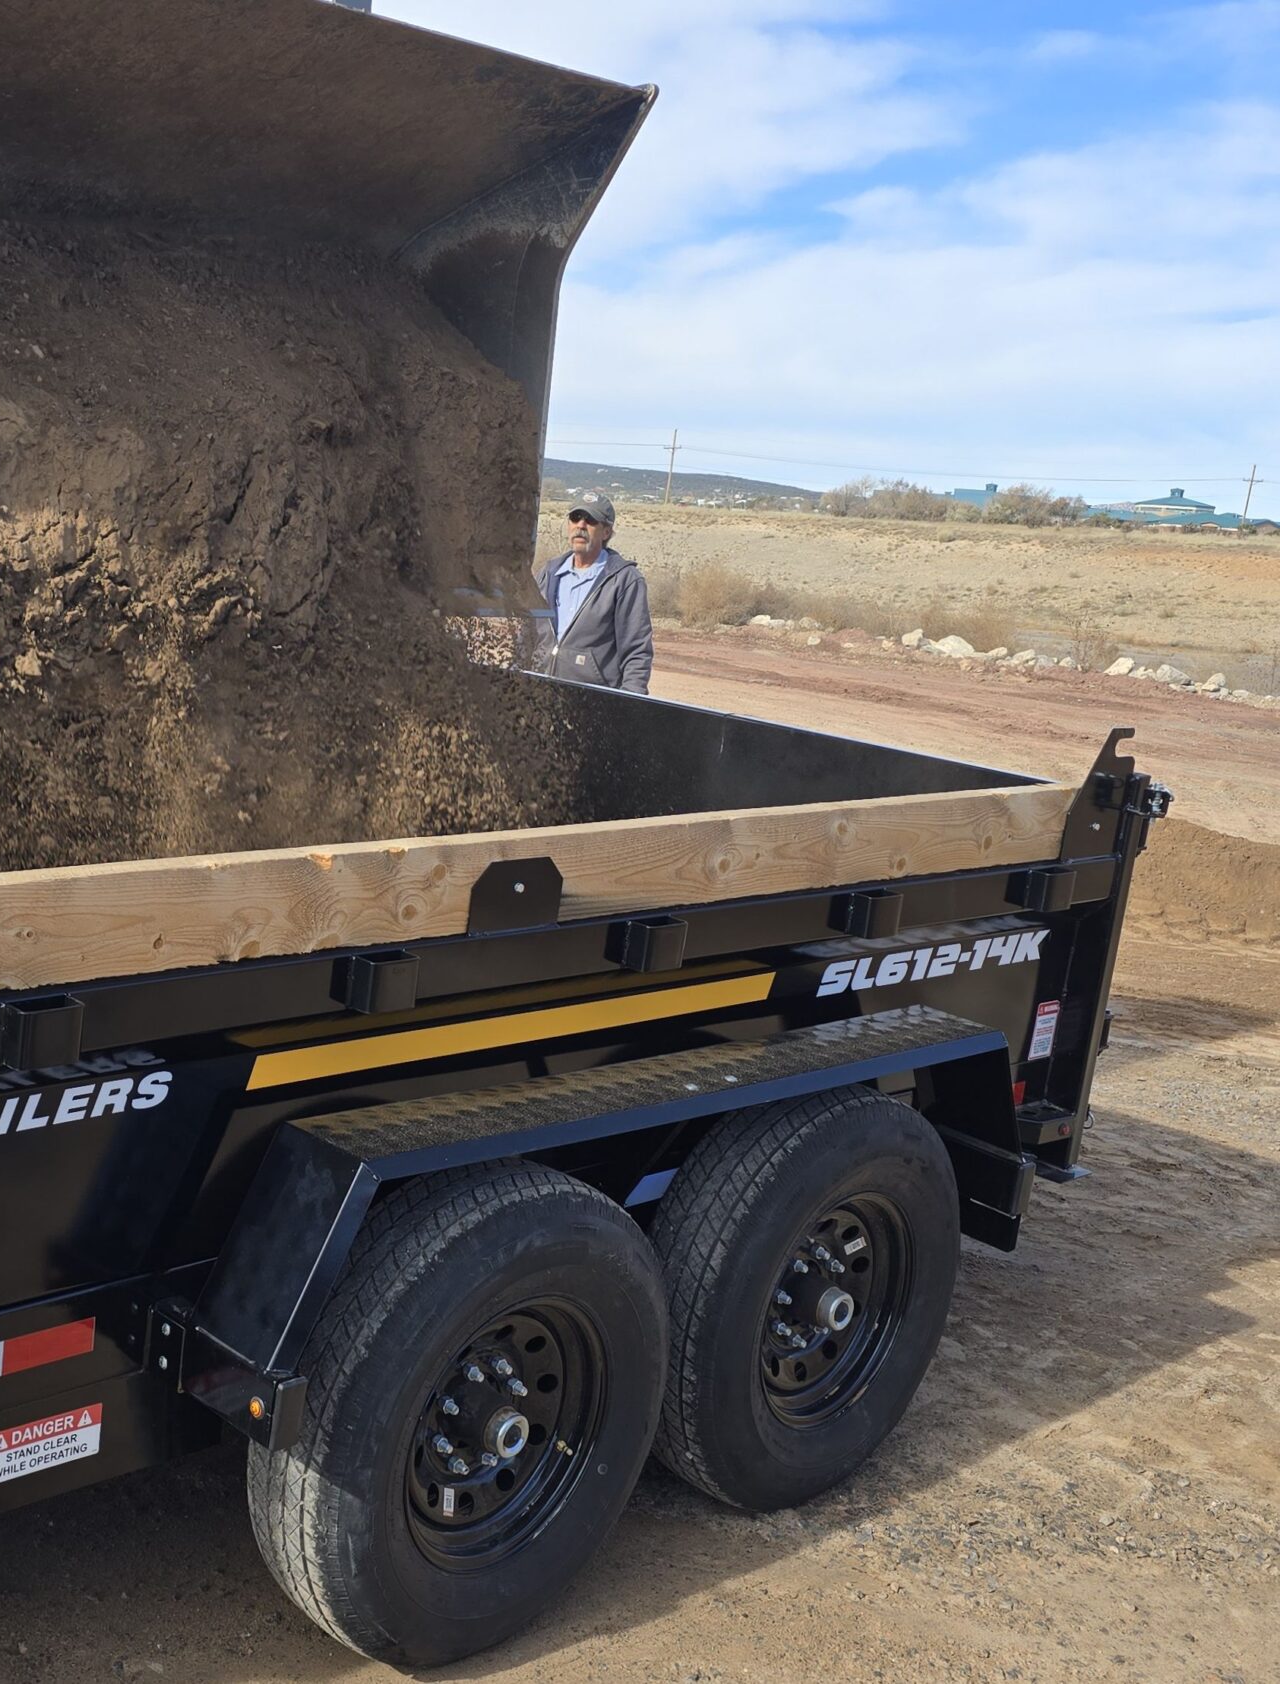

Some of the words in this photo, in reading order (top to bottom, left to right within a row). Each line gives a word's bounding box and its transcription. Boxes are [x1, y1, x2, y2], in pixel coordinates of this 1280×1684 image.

[816, 929, 1051, 998] SL612-14K
[11, 1415, 74, 1445] DANGER
[6, 1445, 40, 1463] STAND
[42, 1434, 77, 1452] CLEAR
[29, 1443, 88, 1467] OPERATING
